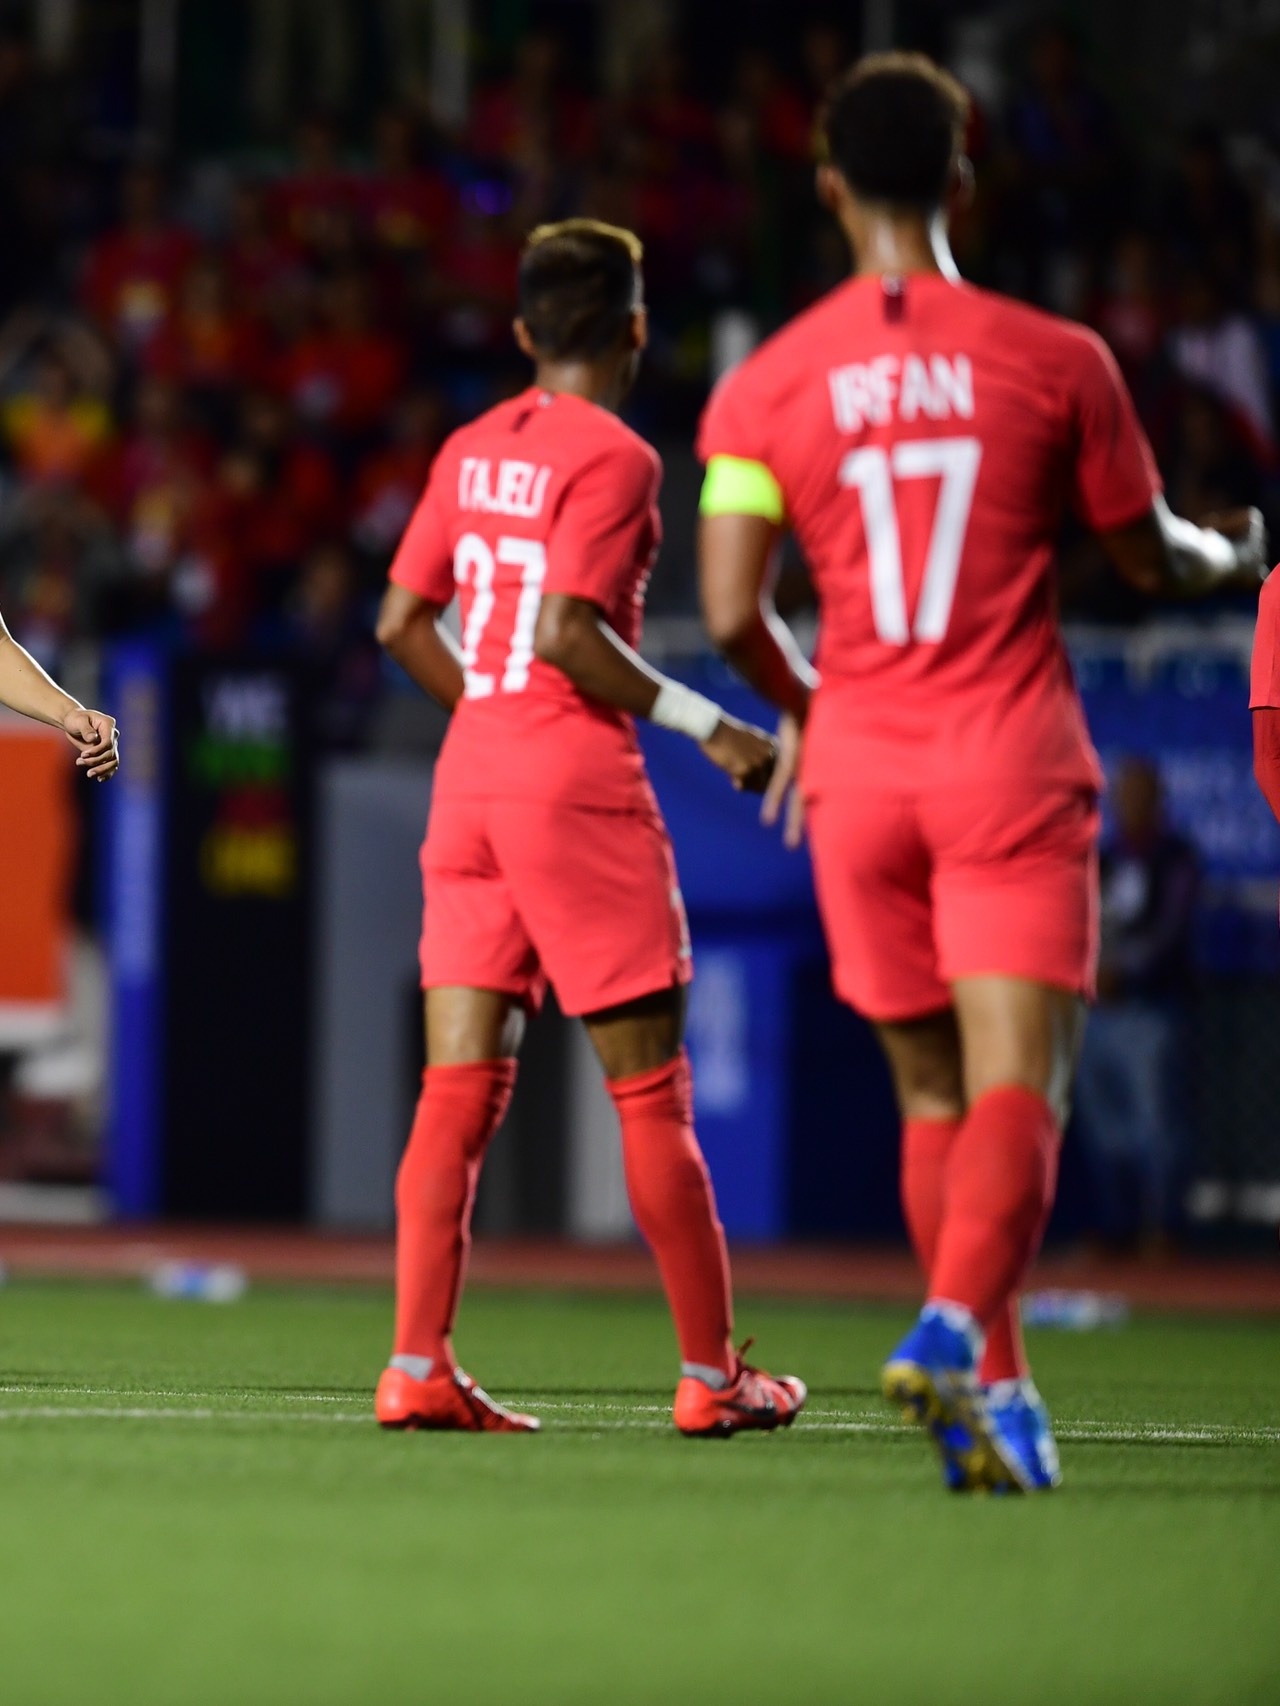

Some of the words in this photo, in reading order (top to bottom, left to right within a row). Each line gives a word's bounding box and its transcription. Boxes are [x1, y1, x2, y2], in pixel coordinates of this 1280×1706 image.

[829, 355, 975, 432] IRFAN
[453, 533, 547, 701] 27
[839, 438, 982, 645] 17
